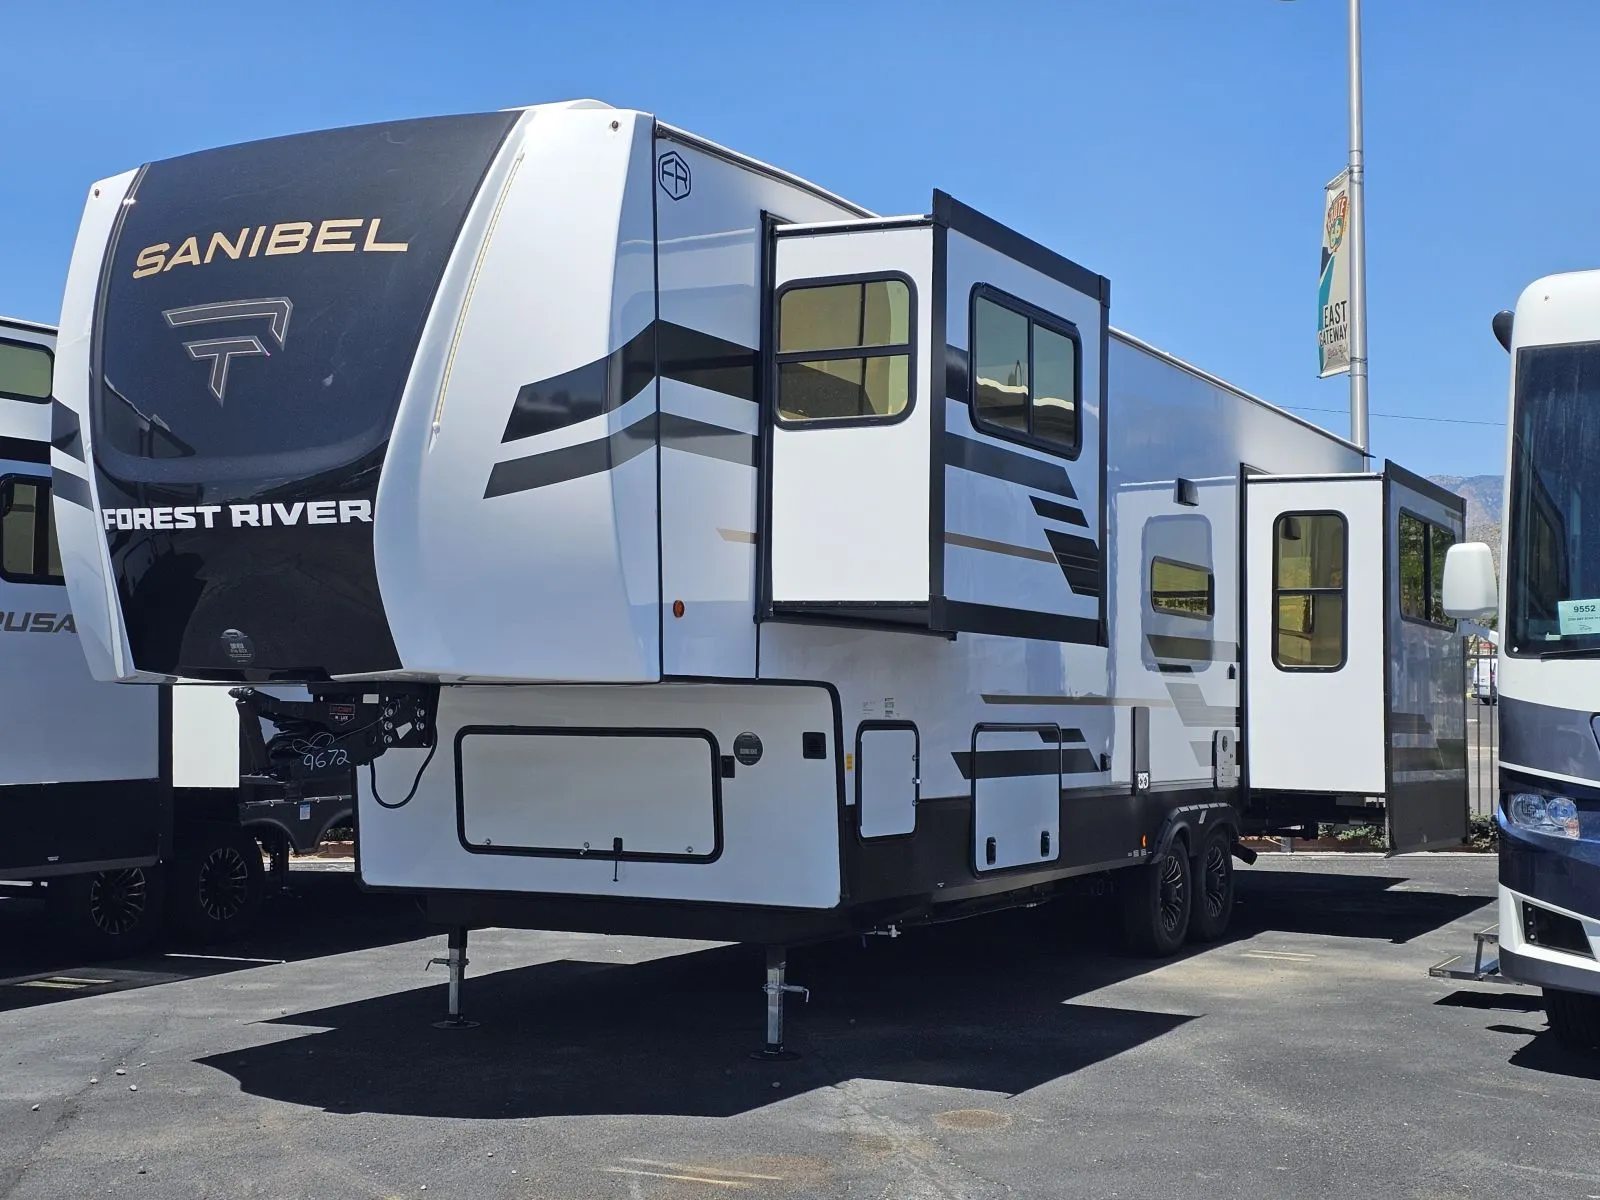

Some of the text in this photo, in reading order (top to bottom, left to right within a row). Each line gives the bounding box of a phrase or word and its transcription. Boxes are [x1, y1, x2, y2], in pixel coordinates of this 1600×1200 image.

[132, 218, 409, 279] SANIBEL
[1325, 300, 1347, 328] EAST
[1319, 323, 1348, 348] GATEWAY
[102, 499, 374, 530] FOREST RIVER
[1573, 604, 1597, 613] 9552
[0, 611, 78, 634] USA
[303, 749, 351, 771] 9672
